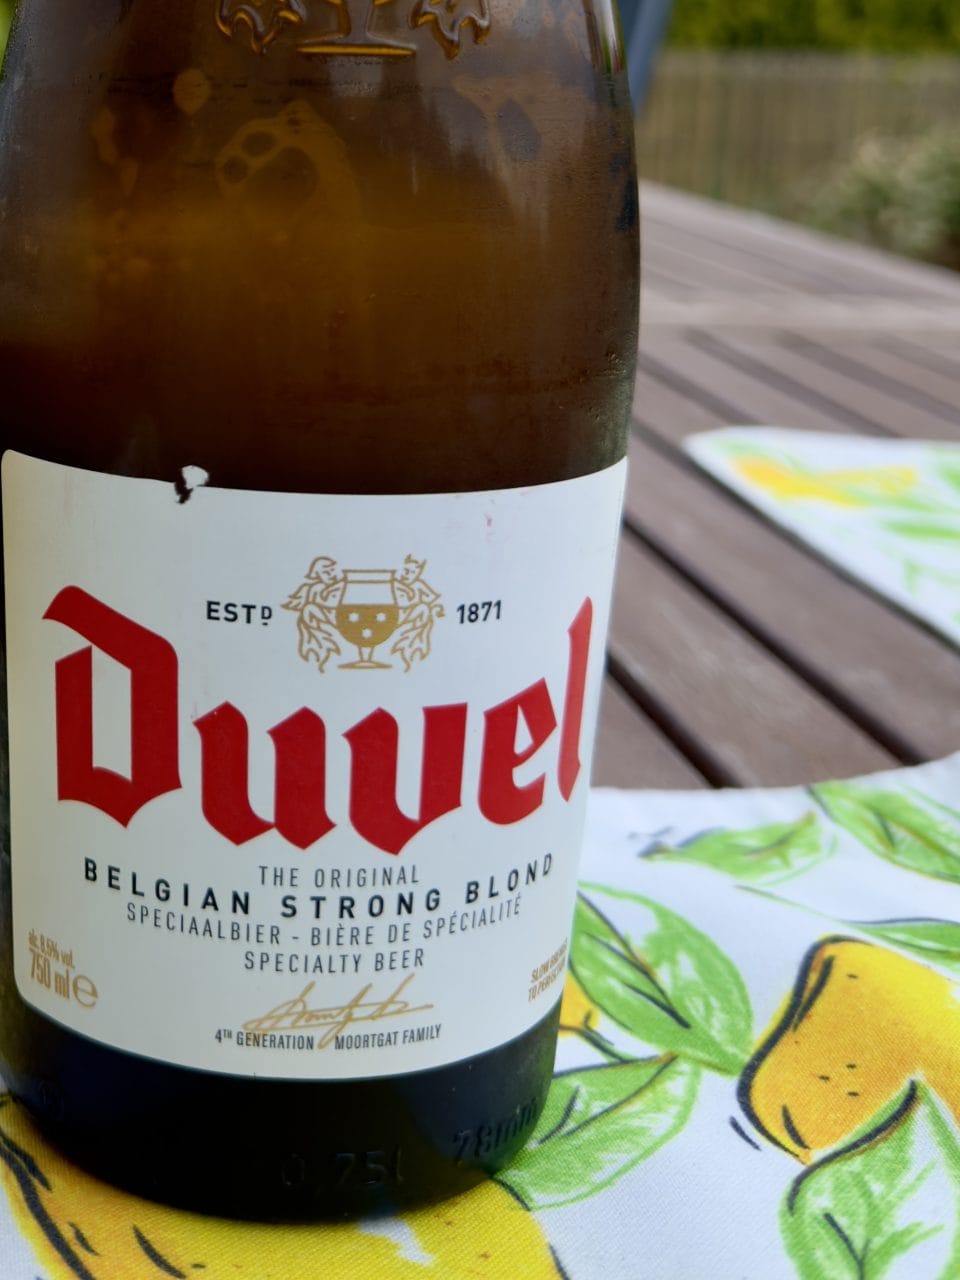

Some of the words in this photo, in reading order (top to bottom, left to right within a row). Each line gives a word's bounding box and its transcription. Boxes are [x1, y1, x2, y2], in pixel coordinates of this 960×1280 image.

[456, 599, 503, 625] 1871
[43, 584, 593, 856] Duvel
[84, 856, 250, 916] BELGIAN
[280, 888, 441, 919] STRONG
[464, 852, 553, 905] BLOND
[258, 865, 300, 888] THE
[313, 864, 420, 888] ORIGINAL
[126, 902, 281, 946] SPECIAALBIER
[310, 922, 375, 947] BIÈRE
[387, 923, 412, 945] DE
[422, 892, 523, 940] SPÉCIALITÉ
[29, 947, 52, 991] 750
[55, 968, 70, 1000] ml
[243, 951, 362, 974] SPECIALTY
[374, 948, 425, 972] BEER
[215, 1029, 233, 1044] 4TH
[236, 1031, 315, 1051] GENERATION
[334, 1031, 400, 1050] MOORTGAT
[402, 1024, 442, 1046] FAMILY
